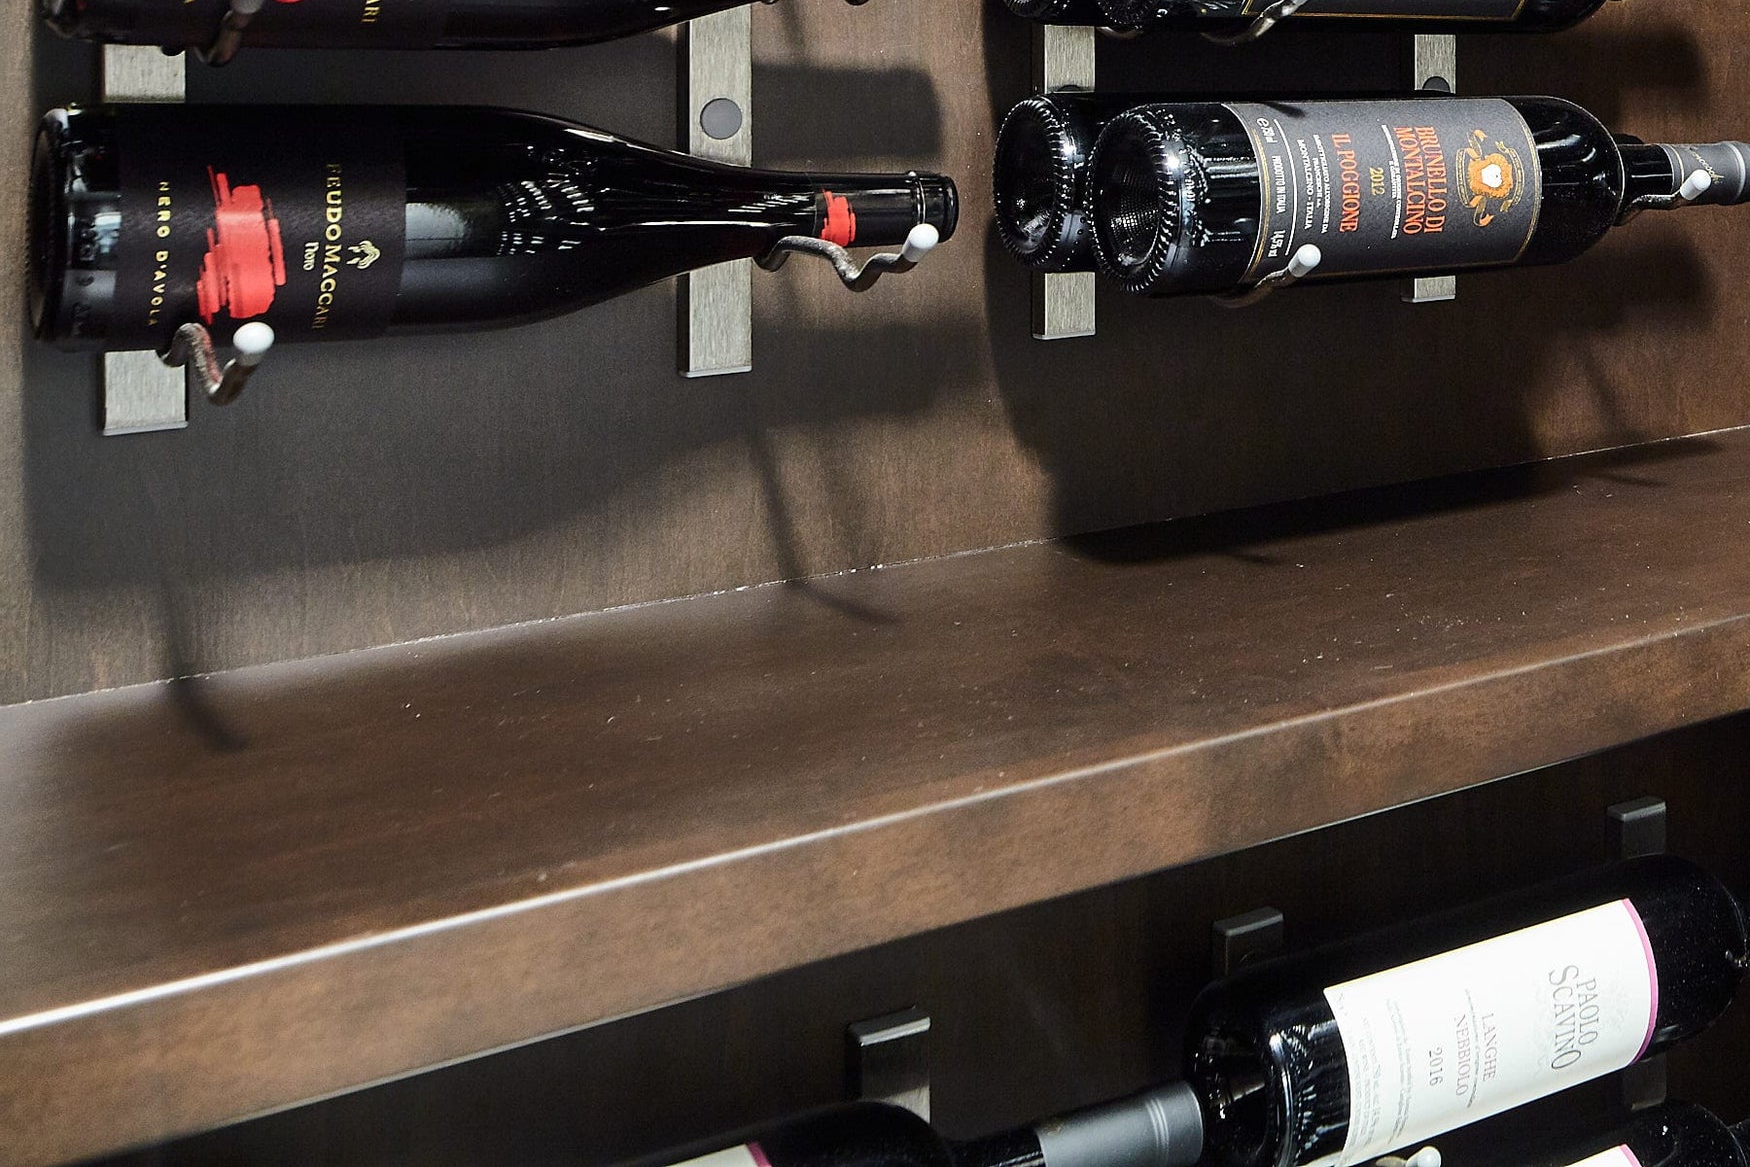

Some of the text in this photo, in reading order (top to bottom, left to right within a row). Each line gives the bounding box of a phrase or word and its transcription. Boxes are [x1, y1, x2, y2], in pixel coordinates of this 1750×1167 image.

[1304, 202, 1315, 230] ITALIA
[1331, 133, 1361, 234] IL POGGIONE
[1369, 167, 1386, 195] 2012
[1393, 126, 1423, 235] MONTALCINO
[1414, 126, 1447, 234] BRUNELLO DI
[148, 180, 170, 326] NERO D'AVOLA
[311, 163, 343, 330] FEUDO MACCARI
[1454, 1014, 1473, 1097] NEBBIOLO
[1481, 1012, 1498, 1083] LANGHE
[1547, 965, 1582, 1070] SCAVINO
[1575, 977, 1600, 1047] PAOLO
[1428, 1047, 1444, 1087] 2016
